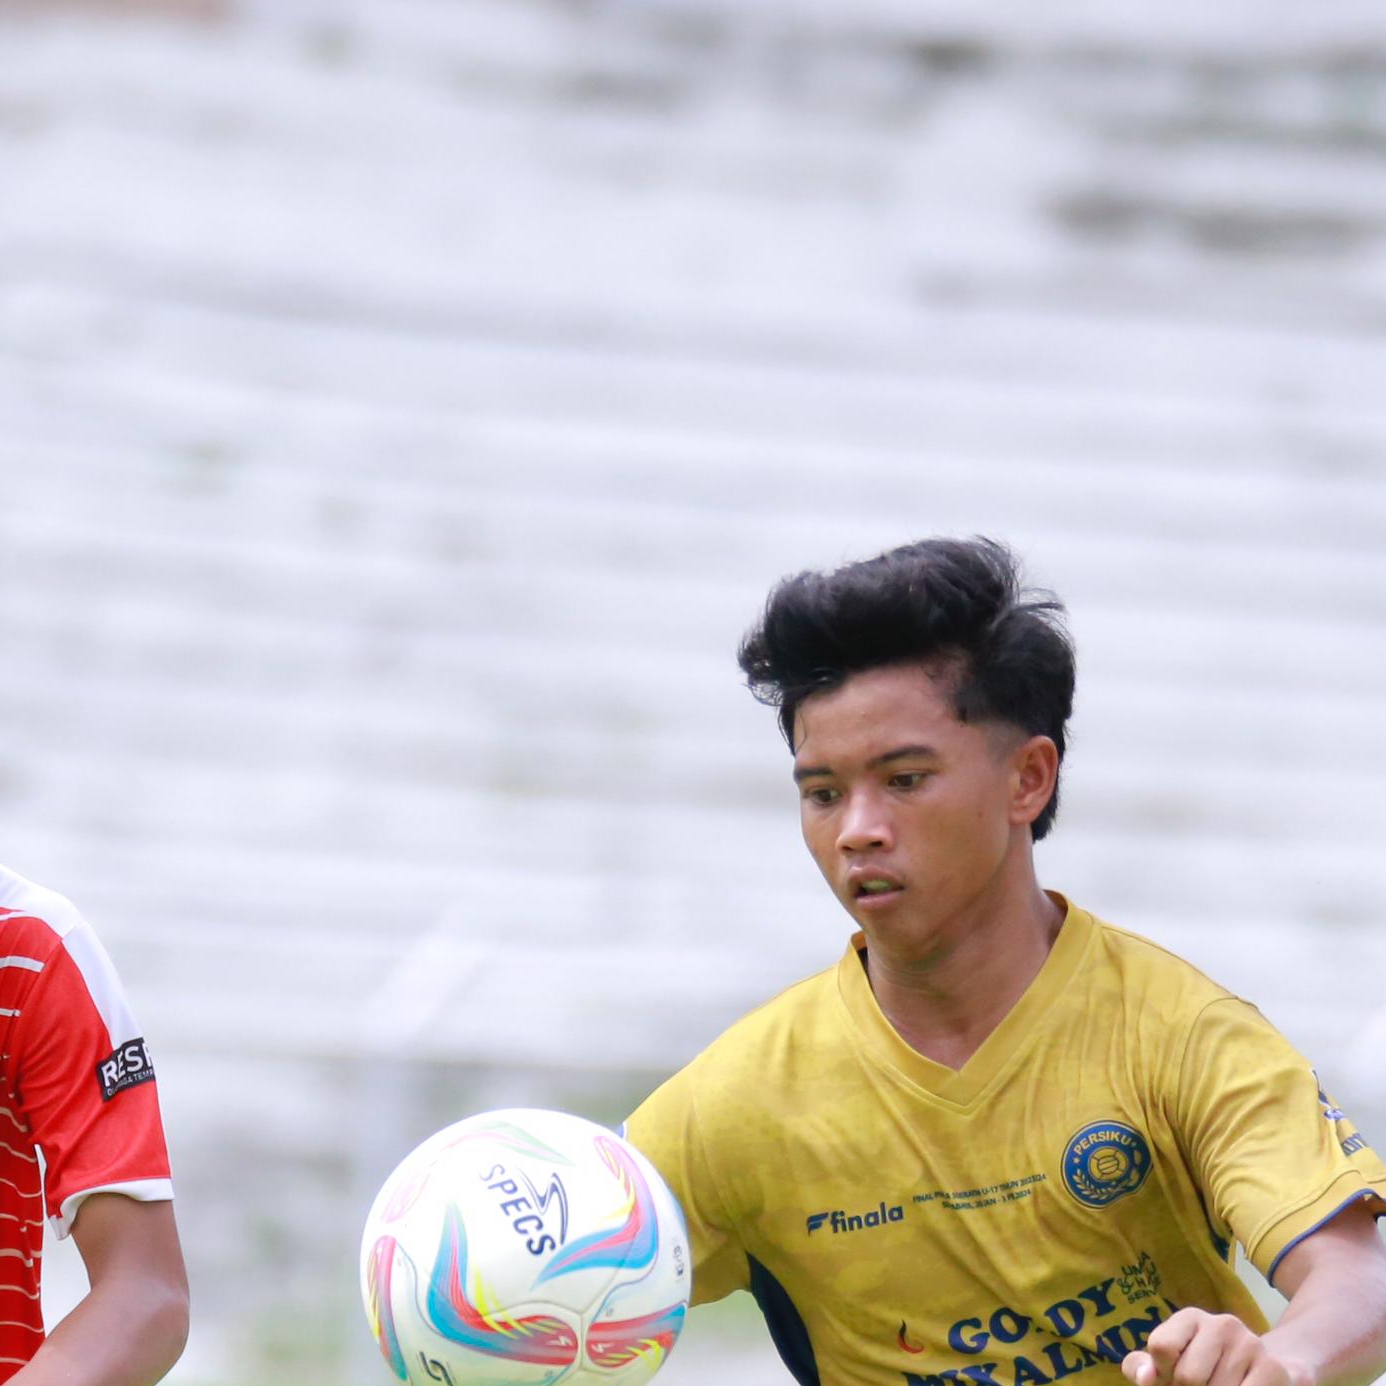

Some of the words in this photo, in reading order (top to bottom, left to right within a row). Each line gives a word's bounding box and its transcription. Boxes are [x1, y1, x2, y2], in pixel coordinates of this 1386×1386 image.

[1074, 1130, 1132, 1155] PERSIKU
[478, 1163, 556, 1256] SPECS
[830, 1202, 904, 1234] finala
